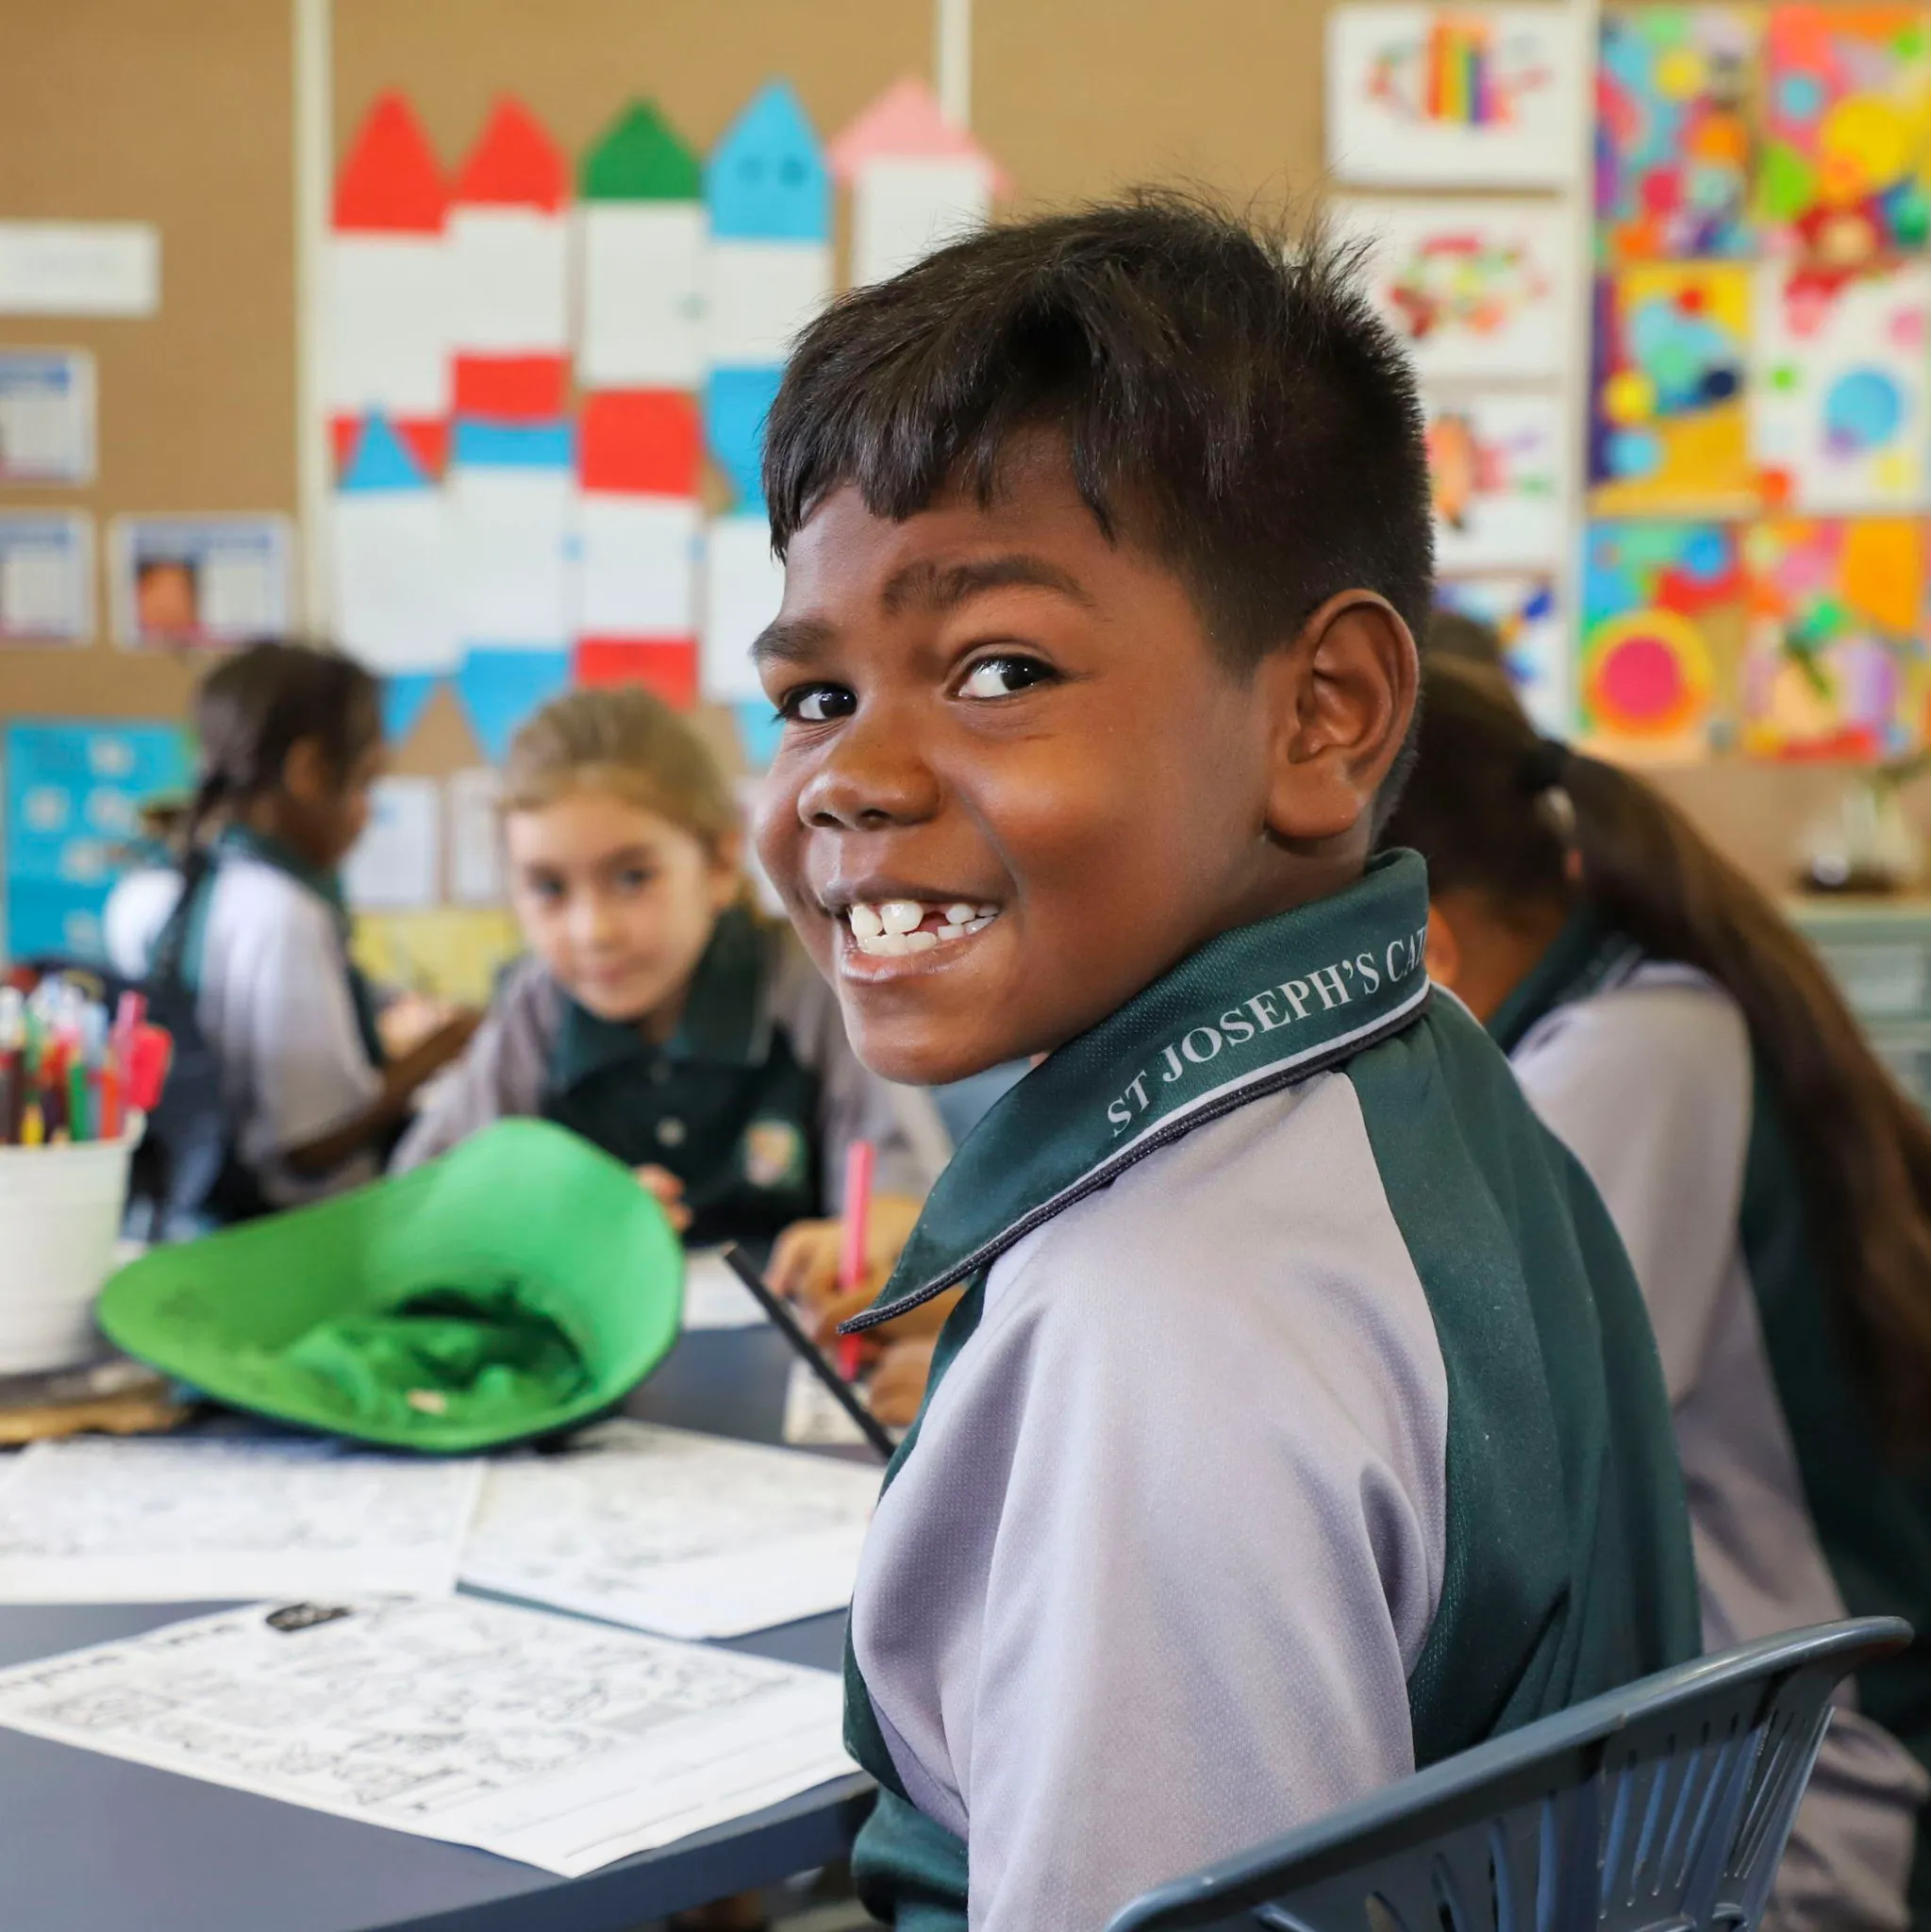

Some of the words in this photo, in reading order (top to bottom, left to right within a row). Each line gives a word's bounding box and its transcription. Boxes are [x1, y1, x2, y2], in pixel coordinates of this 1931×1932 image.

[1107, 1070, 1149, 1137] ST
[1161, 952, 1380, 1083] JOSEPH'S
[1386, 926, 1427, 982] CAT
